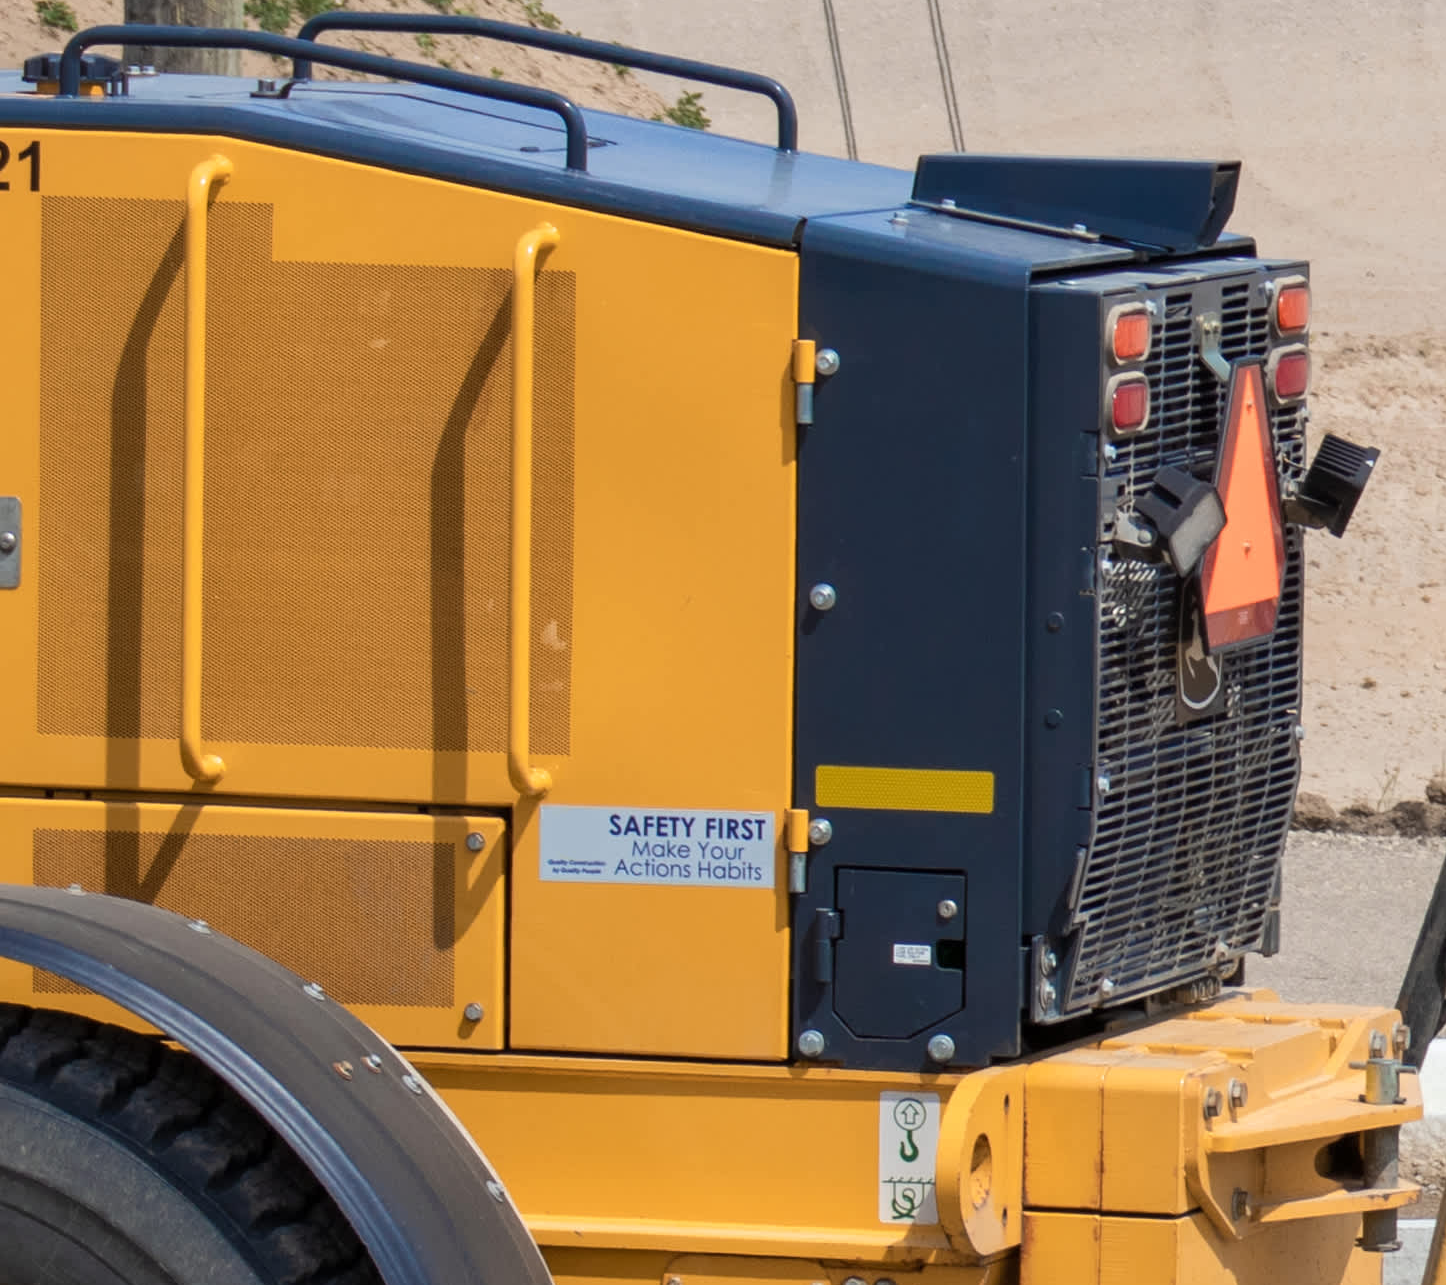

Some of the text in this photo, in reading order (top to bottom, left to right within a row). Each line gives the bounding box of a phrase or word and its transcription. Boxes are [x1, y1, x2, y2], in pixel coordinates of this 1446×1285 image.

[0, 140, 40, 191] 1
[608, 814, 766, 840] SAFETY FIRST
[631, 840, 745, 861] Make Your
[614, 859, 763, 881] Actions Habits
